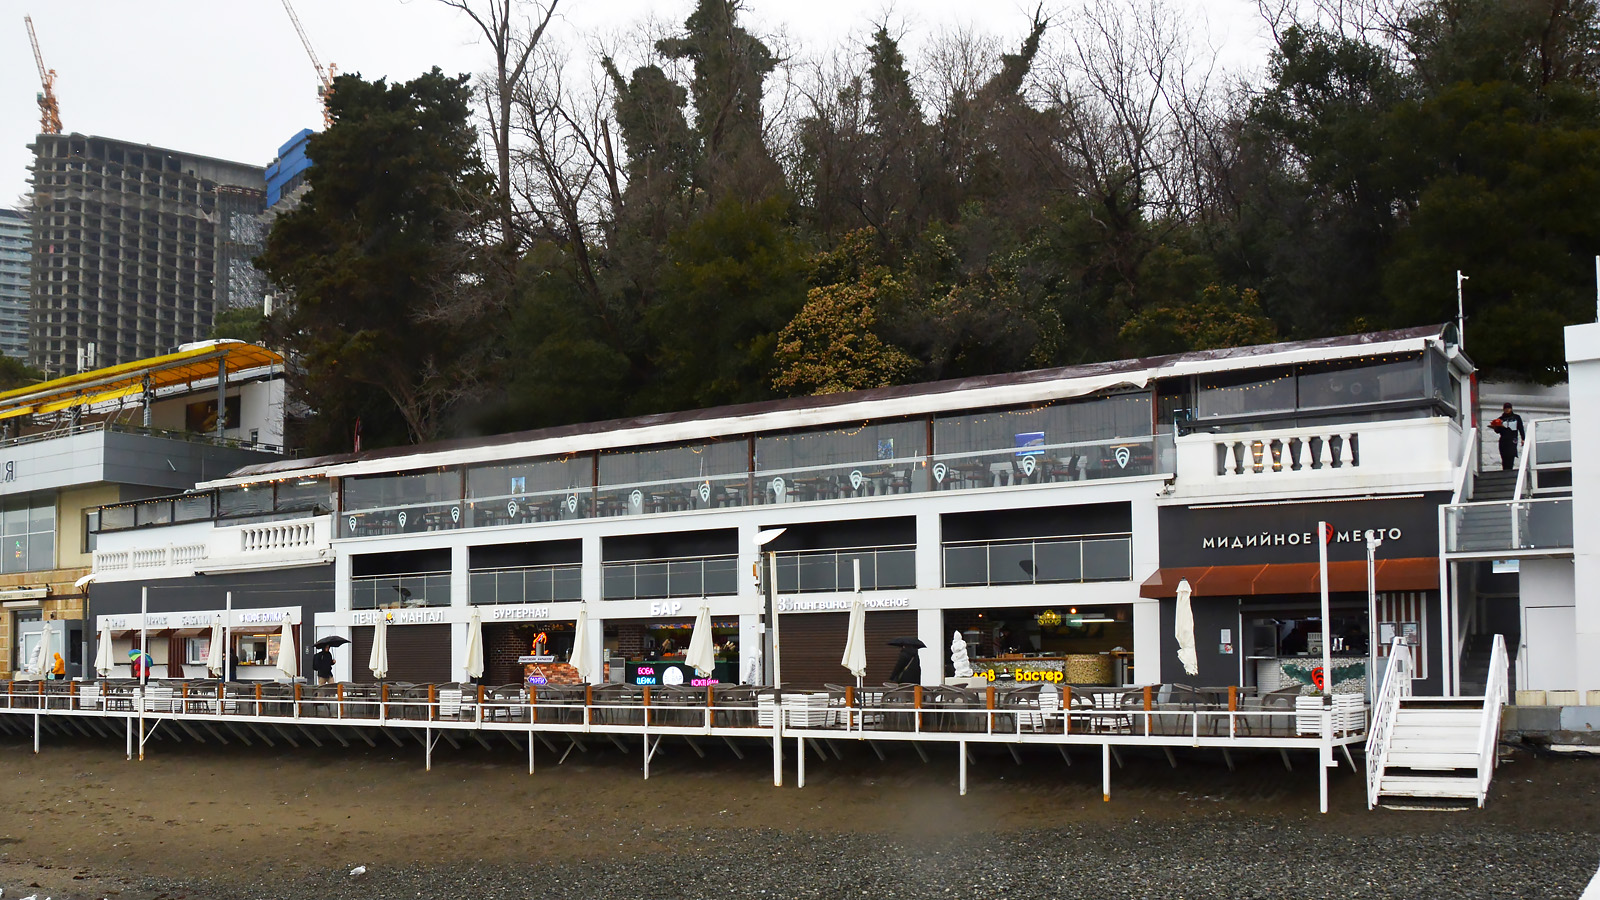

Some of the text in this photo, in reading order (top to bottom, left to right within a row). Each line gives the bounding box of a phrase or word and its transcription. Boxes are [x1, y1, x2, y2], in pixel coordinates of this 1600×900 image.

[1202, 531, 1312, 549] МИДИЙНОЕ
[493, 607, 550, 620] БУРГЕРНАЯ
[650, 601, 682, 616] БАР
[400, 610, 444, 623] МАНГАЛ
[637, 666, 655, 675] БОБА
[972, 668, 1064, 684] лов Бастер
